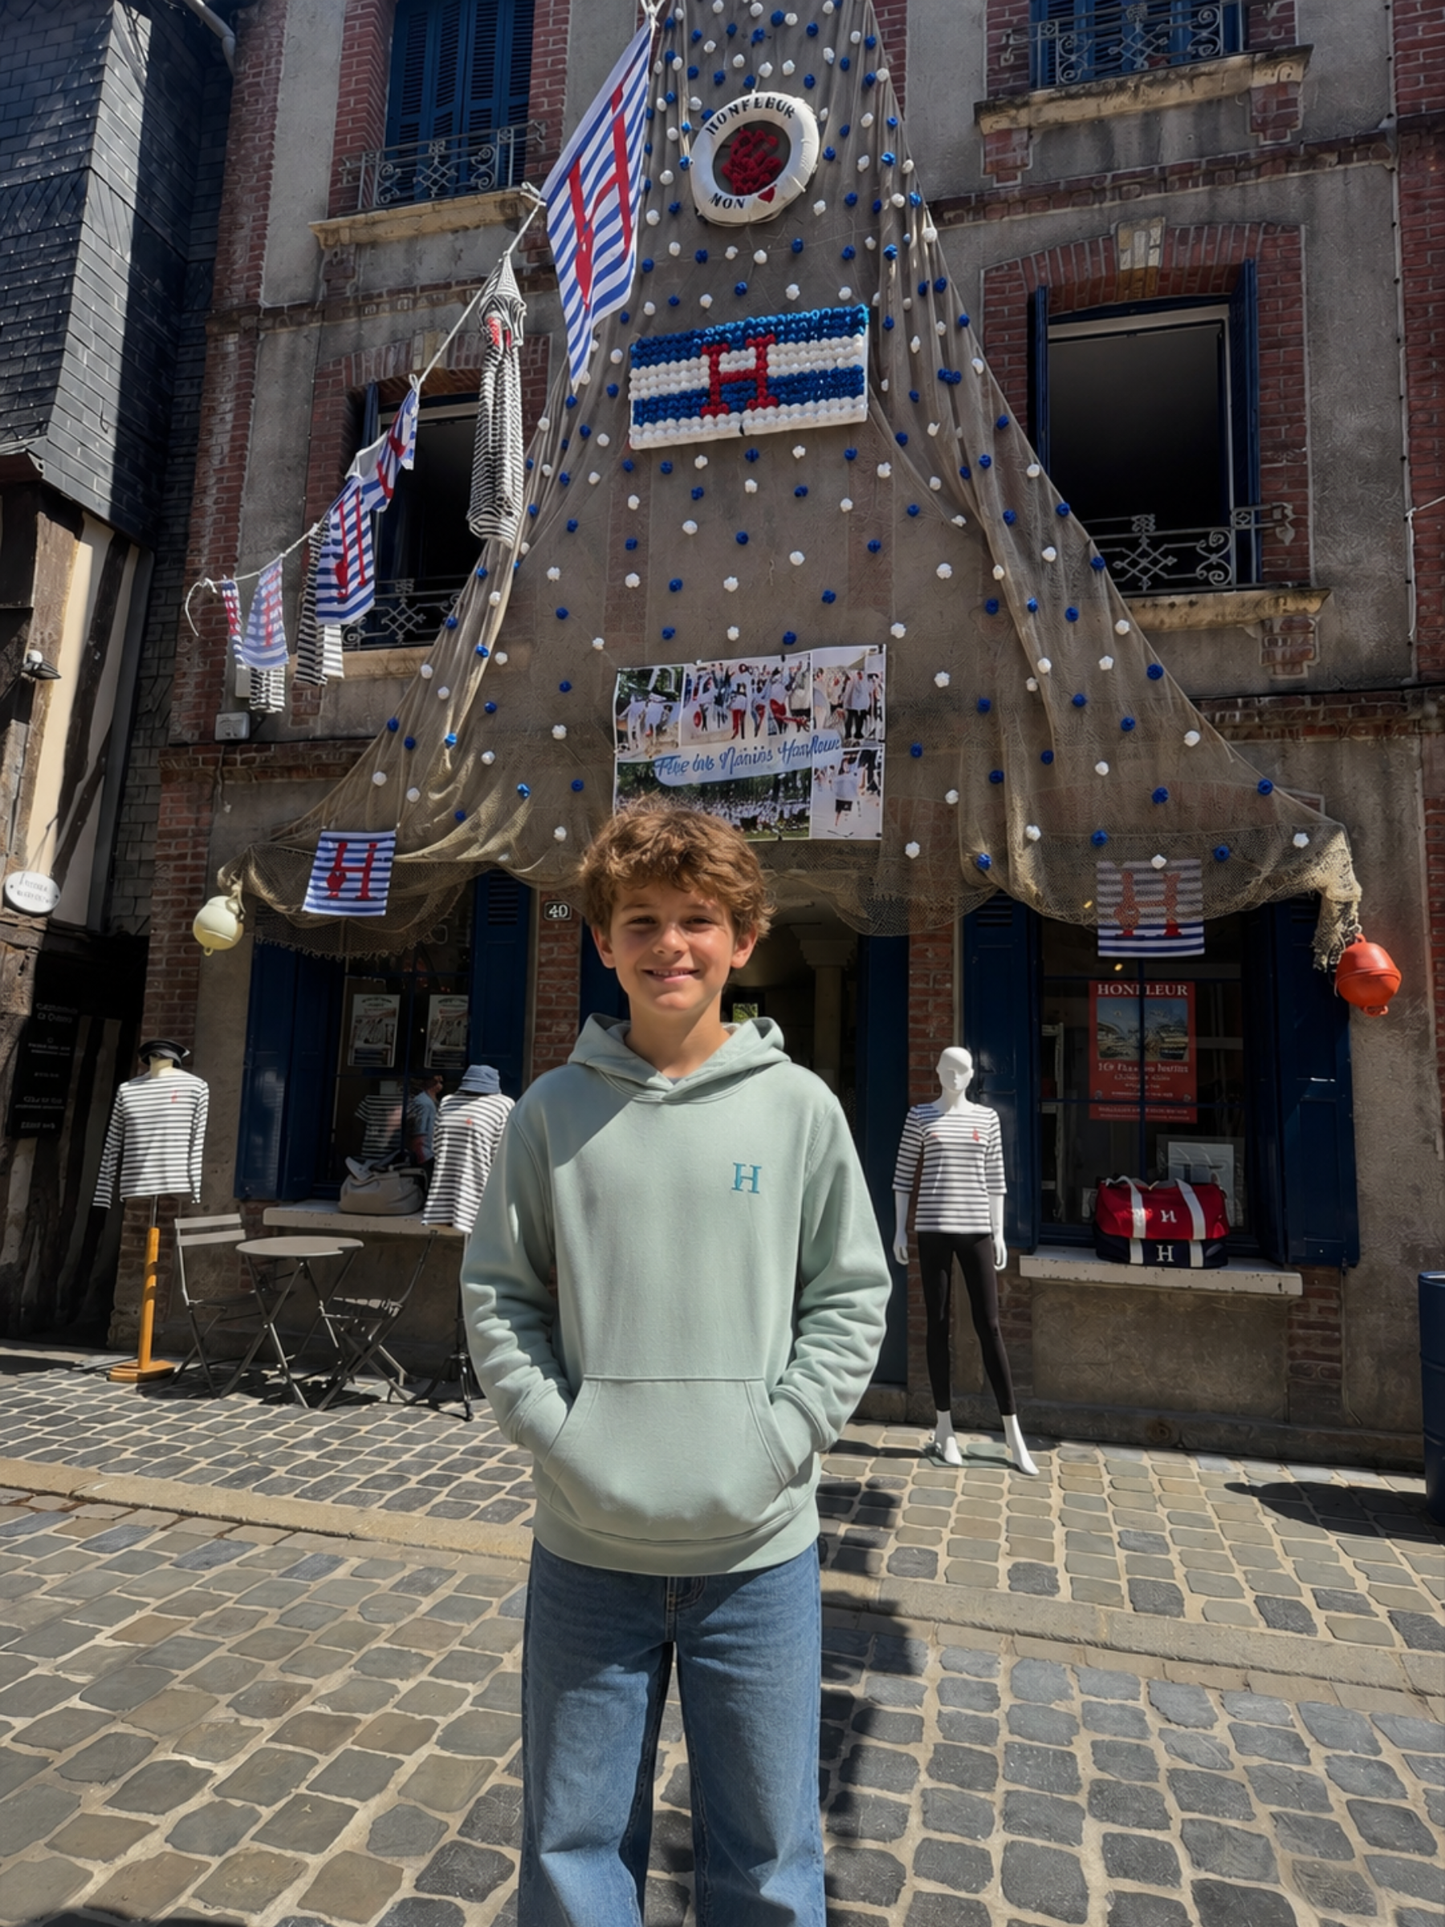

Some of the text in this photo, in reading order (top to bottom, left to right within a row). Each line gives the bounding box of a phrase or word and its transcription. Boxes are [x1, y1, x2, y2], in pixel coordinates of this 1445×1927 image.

[701, 334, 777, 418] H
[323, 841, 379, 900] H
[548, 904, 569, 918] 40
[1113, 871, 1182, 937] H
[731, 1162, 762, 1194] H
[1156, 1244, 1175, 1263] H
